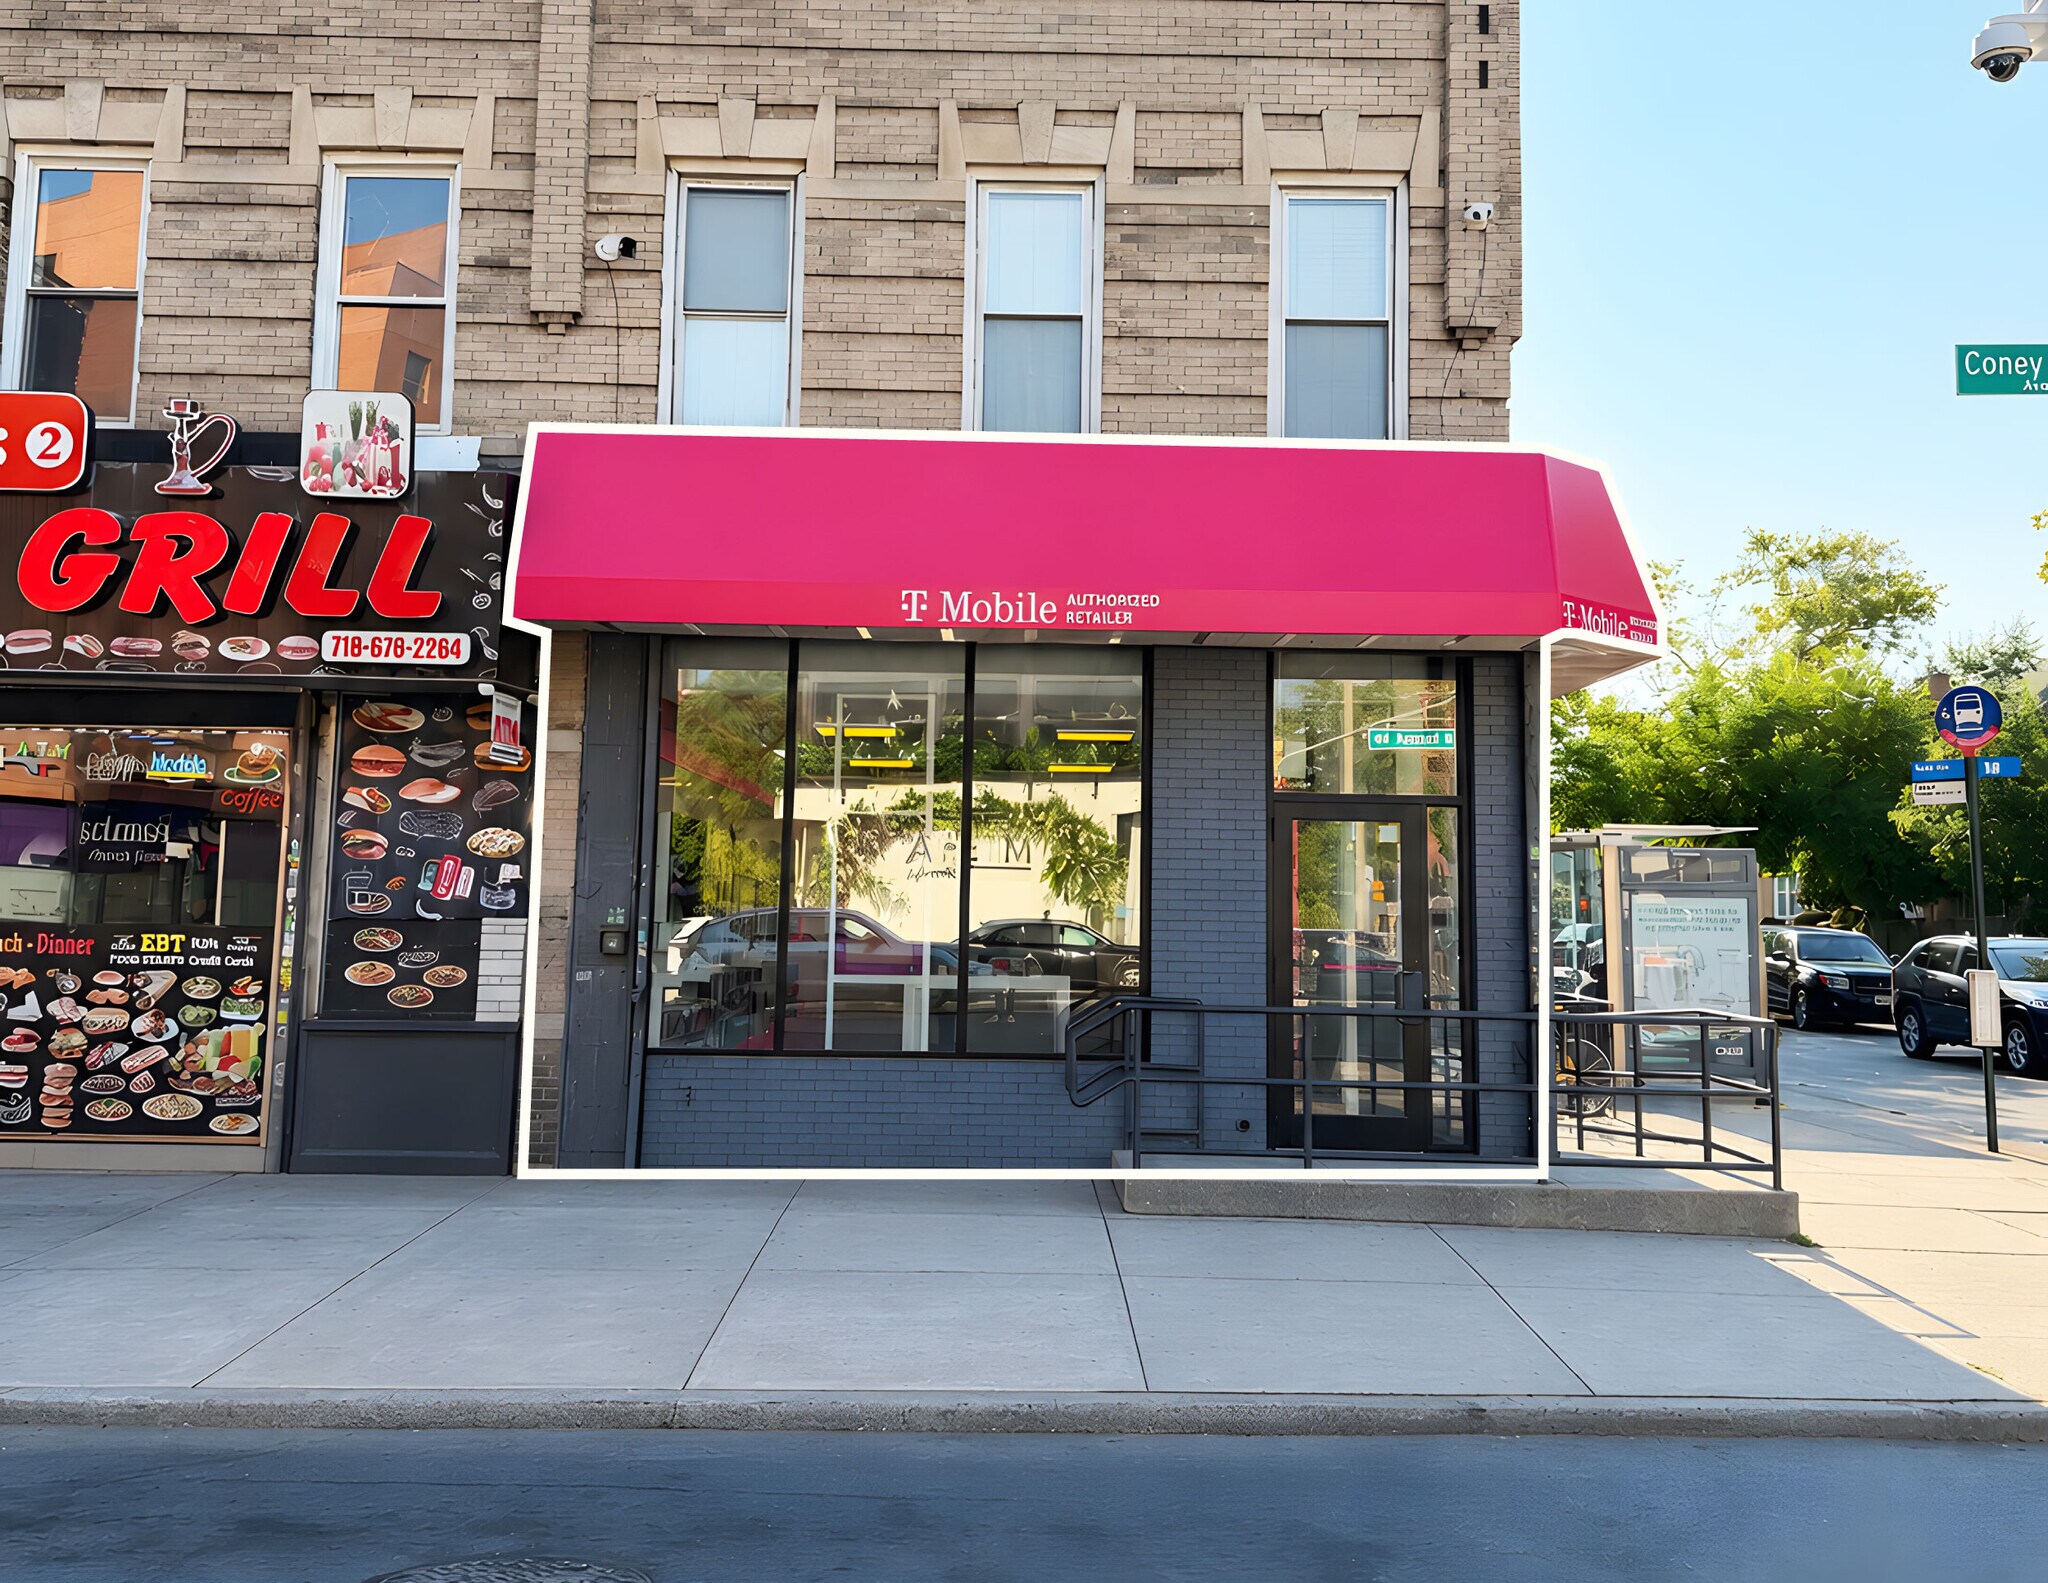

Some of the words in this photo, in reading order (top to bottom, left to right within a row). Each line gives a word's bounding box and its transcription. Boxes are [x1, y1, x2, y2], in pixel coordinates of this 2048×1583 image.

[1964, 350, 2043, 381] Coney
[36, 426, 62, 460] 2
[17, 507, 443, 624] GRILL
[1066, 611, 1133, 624] RETAILER
[331, 635, 461, 659] 718-678-2264
[220, 787, 283, 814] Coffee
[37, 933, 95, 955] Dinner
[140, 934, 186, 953] EBT
